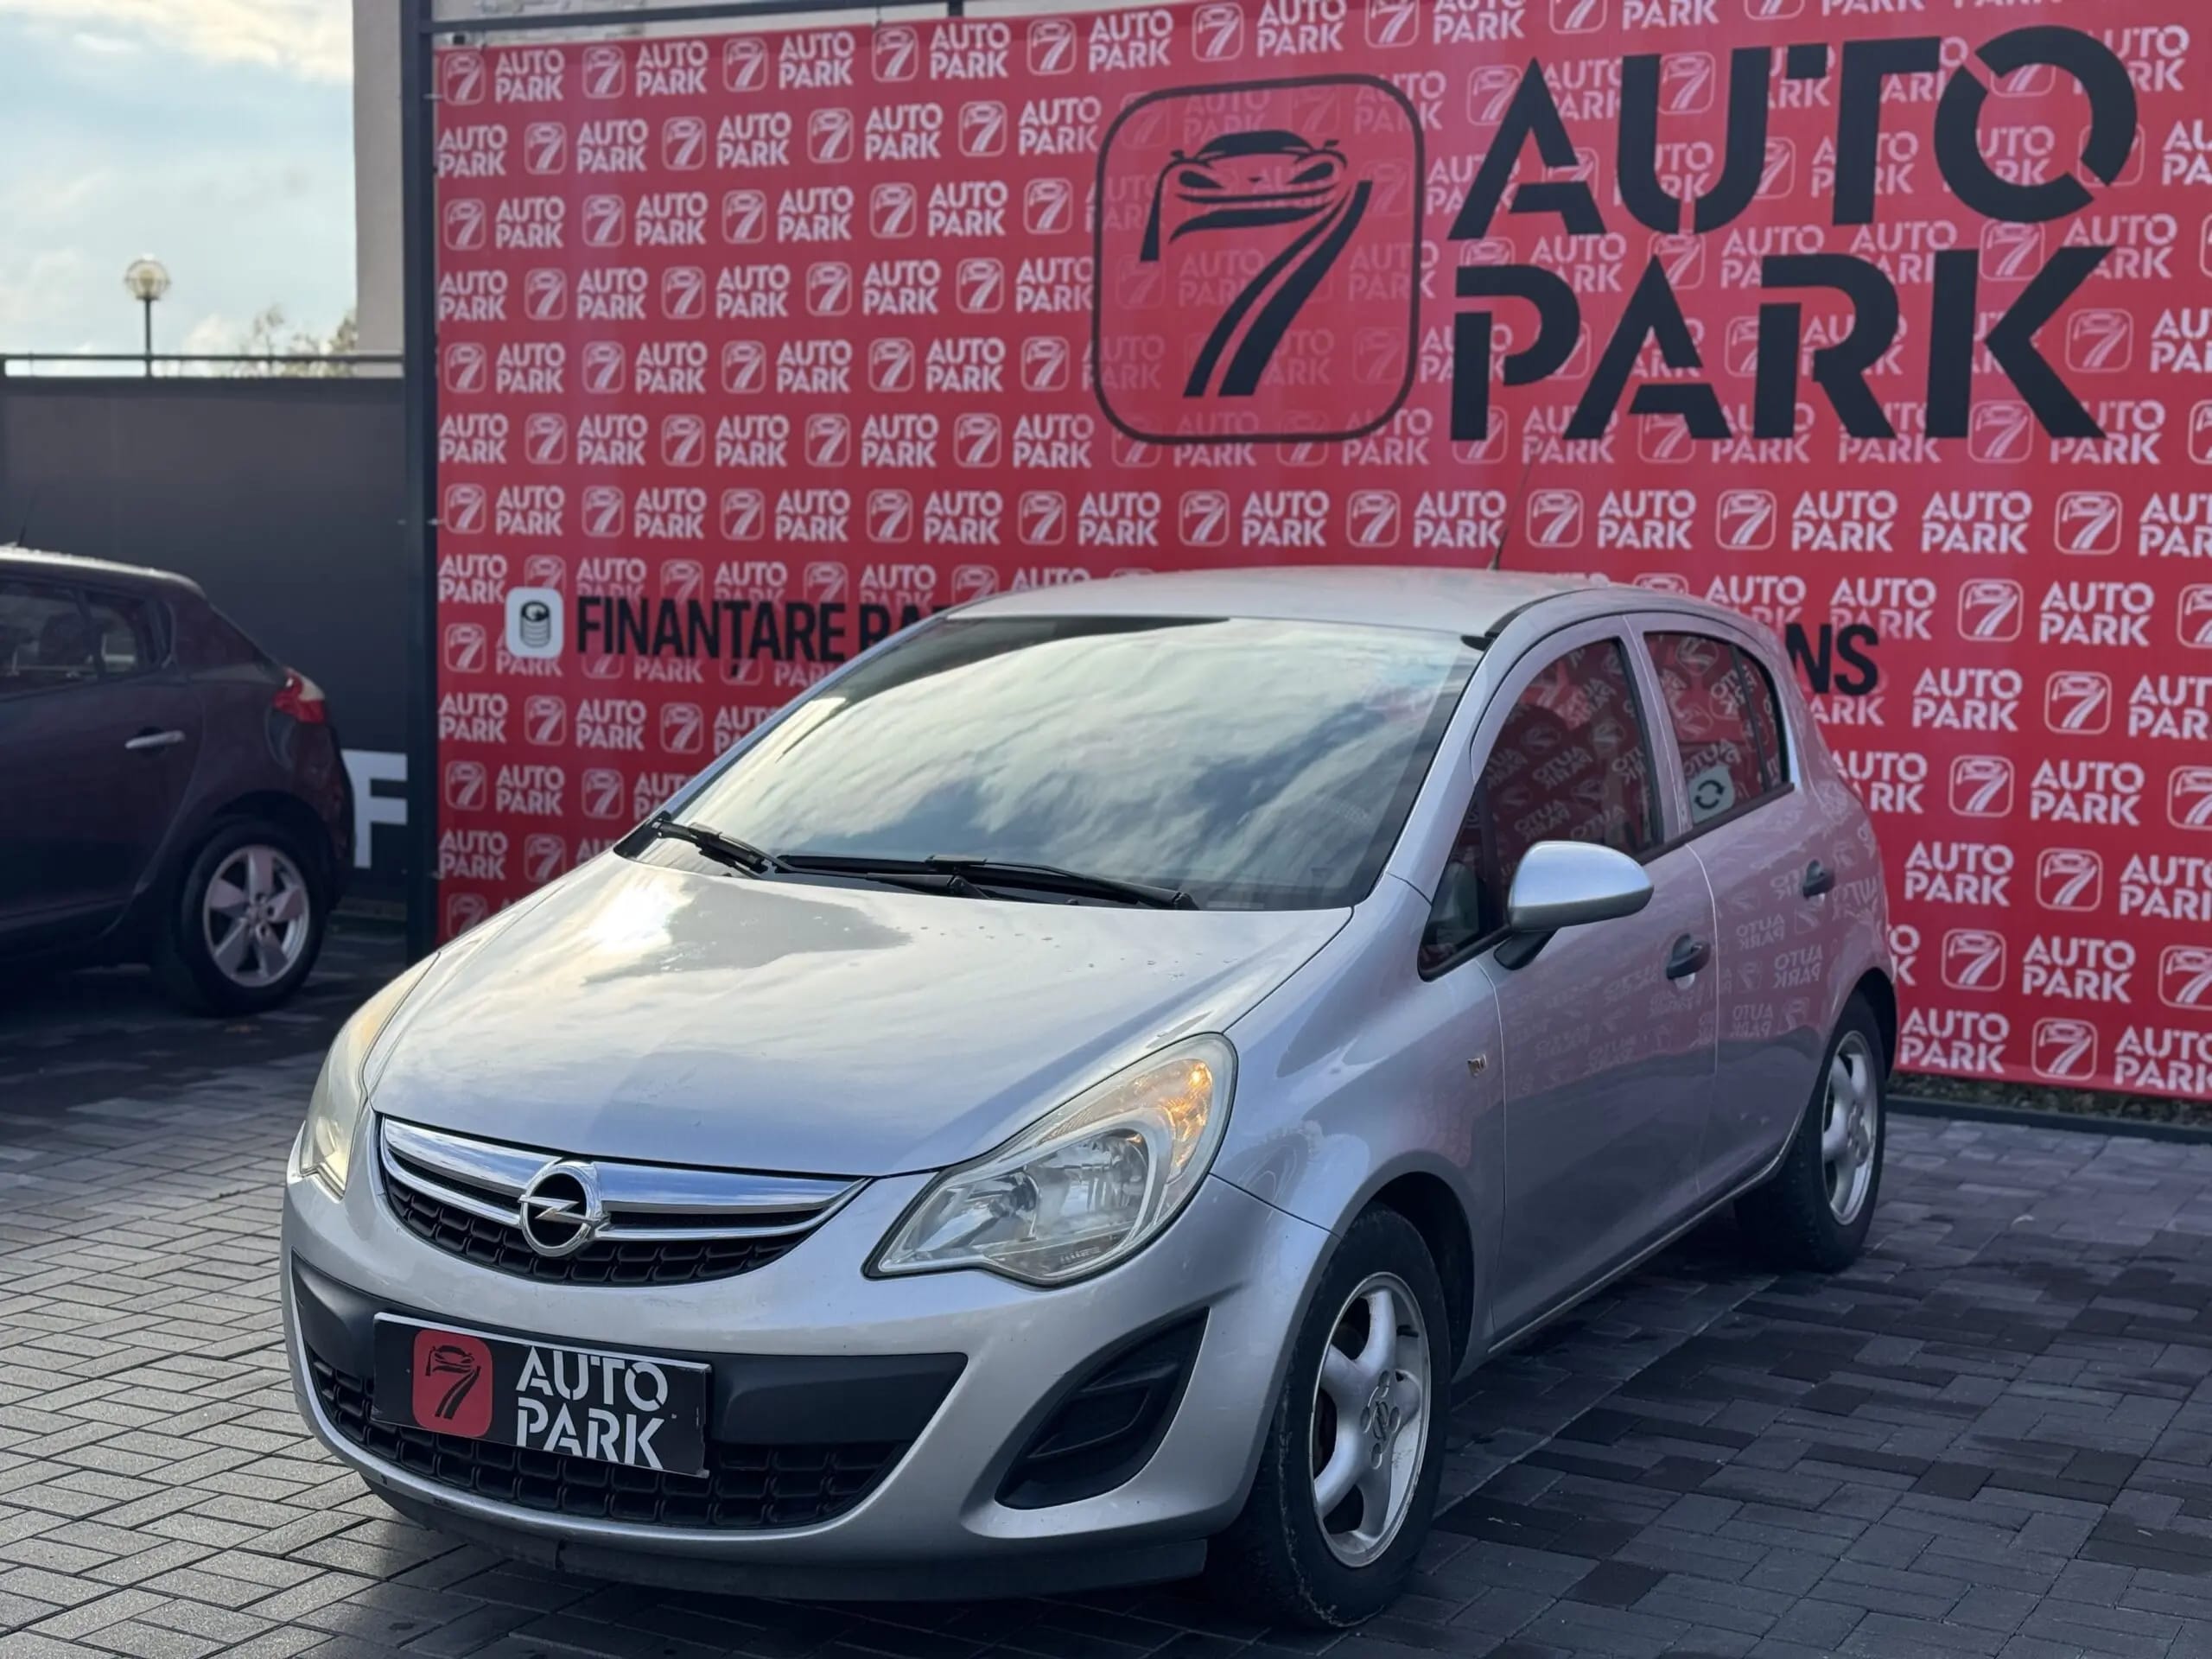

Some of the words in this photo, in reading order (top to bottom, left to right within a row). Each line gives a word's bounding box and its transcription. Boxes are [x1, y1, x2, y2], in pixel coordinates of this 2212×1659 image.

[1090, 10, 1173, 43] AUTO
[1258, 0, 1346, 29] AUTO
[1433, 9, 1524, 44] PARK
[1621, 0, 1719, 30] PARK
[779, 32, 855, 61] AUTO
[931, 23, 1010, 50] AUTO
[1257, 22, 1343, 57] PARK
[495, 49, 564, 76] AUTO
[636, 41, 708, 69] AUTO
[931, 50, 1007, 79] PARK
[1090, 38, 1170, 72] PARK
[637, 67, 706, 96] PARK
[779, 58, 852, 88] PARK
[496, 74, 563, 102] PARK
[866, 103, 943, 133] AUTO
[1020, 97, 1102, 127] AUTO
[439, 125, 508, 151] AUTO
[577, 119, 648, 146] AUTO
[717, 112, 791, 141] AUTO
[1020, 124, 1099, 155] PARK
[1447, 25, 2138, 240] AUTO
[2162, 119, 2212, 152] AU
[577, 145, 645, 173] PARK
[717, 139, 789, 168] PARK
[866, 131, 940, 161] PARK
[438, 150, 506, 178] PARK
[636, 192, 708, 219] AUTO
[779, 187, 854, 214] AUTO
[929, 181, 1007, 208] AUTO
[496, 197, 564, 222] AUTO
[929, 209, 1004, 237] PARK
[496, 223, 563, 248] PARK
[636, 219, 705, 245] PARK
[779, 213, 850, 242] PARK
[1721, 225, 1825, 257] AUTO
[1849, 220, 1958, 252] AUTO
[2063, 213, 2177, 247] AUTO
[1530, 232, 1627, 264] AUTO
[439, 270, 507, 295] AUTO
[577, 268, 647, 293] AUTO
[716, 264, 790, 291] AUTO
[863, 260, 940, 287] AUTO
[1016, 256, 1094, 284] AUTO
[1557, 263, 1623, 294] ARK
[439, 296, 505, 321] PARK
[577, 294, 645, 319] PARK
[716, 291, 787, 318] PARK
[863, 287, 938, 315] PARK
[1016, 284, 1093, 312] PARK
[2150, 307, 2212, 340] AU
[497, 343, 565, 368] AUTO
[636, 342, 707, 366] AUTO
[777, 340, 852, 365] AUTO
[926, 338, 1005, 364] AUTO
[1450, 245, 2117, 441] PARK
[497, 368, 563, 392] PARK
[636, 367, 705, 392] PARK
[778, 366, 849, 392] PARK
[926, 365, 1001, 391] PARK
[439, 414, 508, 438] AUTO
[577, 415, 647, 439] AUTO
[716, 415, 789, 441] AUTO
[862, 414, 938, 440] AUTO
[1014, 414, 1095, 440] AUTO
[439, 437, 505, 463] PARK
[578, 440, 645, 465] PARK
[716, 441, 786, 466] PARK
[861, 441, 935, 467] PARK
[1014, 442, 1090, 467] PARK
[1173, 439, 1257, 467] PARK
[1343, 436, 1430, 467] PARK
[1522, 434, 1615, 464] PARK
[1712, 435, 1811, 464] PARK
[1839, 433, 1942, 463] PARK
[2050, 432, 2162, 464] PARK
[496, 486, 564, 510] AUTO
[635, 488, 706, 513] AUTO
[776, 490, 850, 515] AUTO
[925, 491, 1002, 517] AUTO
[1078, 492, 1160, 518] AUTO
[1243, 491, 1329, 518] AUTO
[1414, 491, 1506, 518] AUTO
[1599, 490, 1695, 518] AUTO
[1793, 491, 1897, 520] AUTO
[1923, 492, 2031, 521] AUTO
[2139, 493, 2212, 524] AUT
[496, 510, 562, 536] PARK
[635, 512, 703, 538] PARK
[776, 514, 847, 541] PARK
[925, 517, 999, 544] PARK
[1078, 519, 1157, 546] PARK
[1243, 519, 1325, 546] PARK
[1414, 519, 1503, 548] PARK
[1598, 519, 1692, 549] PARK
[1792, 521, 1892, 551] PARK
[1923, 522, 2027, 553] PARK
[2139, 523, 2212, 557] PAR
[438, 555, 507, 579] AUTO
[575, 557, 647, 584] AUTO
[715, 562, 787, 588] AUTO
[860, 564, 937, 591] AUTO
[439, 578, 504, 603] PARK
[1704, 575, 1807, 606] AUTO
[1829, 577, 1937, 608] AUTO
[2041, 582, 2153, 613] AUTO
[2040, 613, 2149, 645] PARK
[496, 651, 563, 677] PARK
[634, 655, 704, 684] PARK
[1914, 669, 2022, 699] AUTO
[2130, 676, 2212, 707] AUT
[439, 693, 508, 718] AUTO
[576, 699, 646, 725] AUTO
[1809, 696, 1885, 726] ARK
[1913, 698, 2018, 731] PARK
[439, 715, 505, 742] PARK
[577, 723, 644, 750] PARK
[2129, 705, 2212, 741] PAR
[497, 766, 564, 791] AUTO
[2031, 760, 2144, 793] AUTO
[497, 788, 562, 816] PARK
[2031, 790, 2139, 825] PARK
[439, 830, 507, 855] AUTO
[439, 851, 505, 880] PARK
[1905, 842, 2013, 874] AUTO
[1905, 871, 2009, 906] PARK
[2024, 936, 2135, 970] AUTO
[2023, 965, 2131, 1002] PARK
[1901, 1008, 2009, 1042] AUTO
[1900, 1036, 2005, 1073] PARK
[516, 1344, 669, 1412] AUTO
[516, 1396, 664, 1469] PARK
